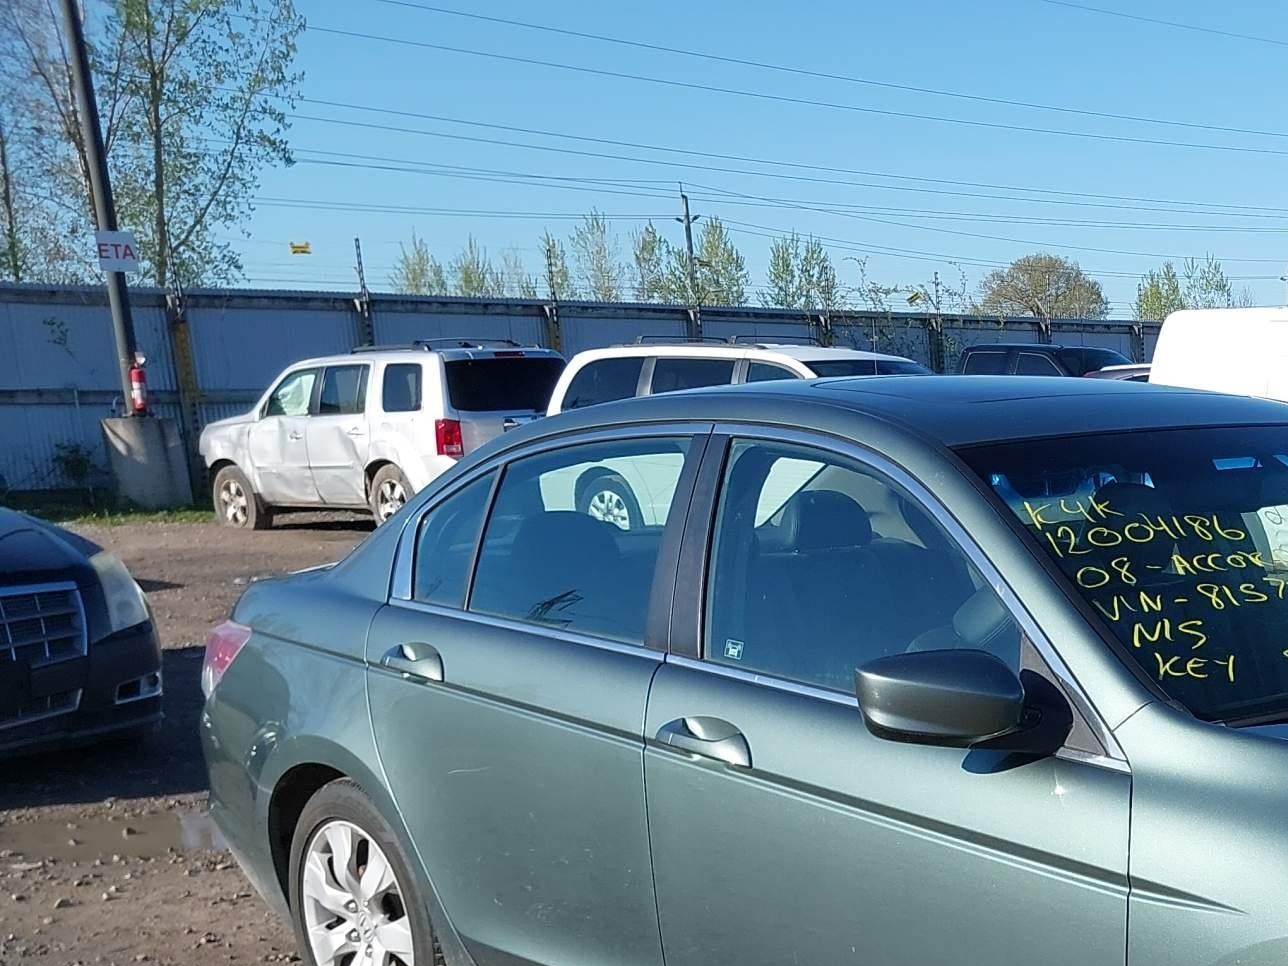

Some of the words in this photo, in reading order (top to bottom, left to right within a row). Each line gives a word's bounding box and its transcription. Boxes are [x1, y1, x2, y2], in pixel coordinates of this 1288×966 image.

[98, 243, 136, 260] ETA
[1045, 514, 1246, 558] 12004186
[1154, 651, 1236, 682] KEY
